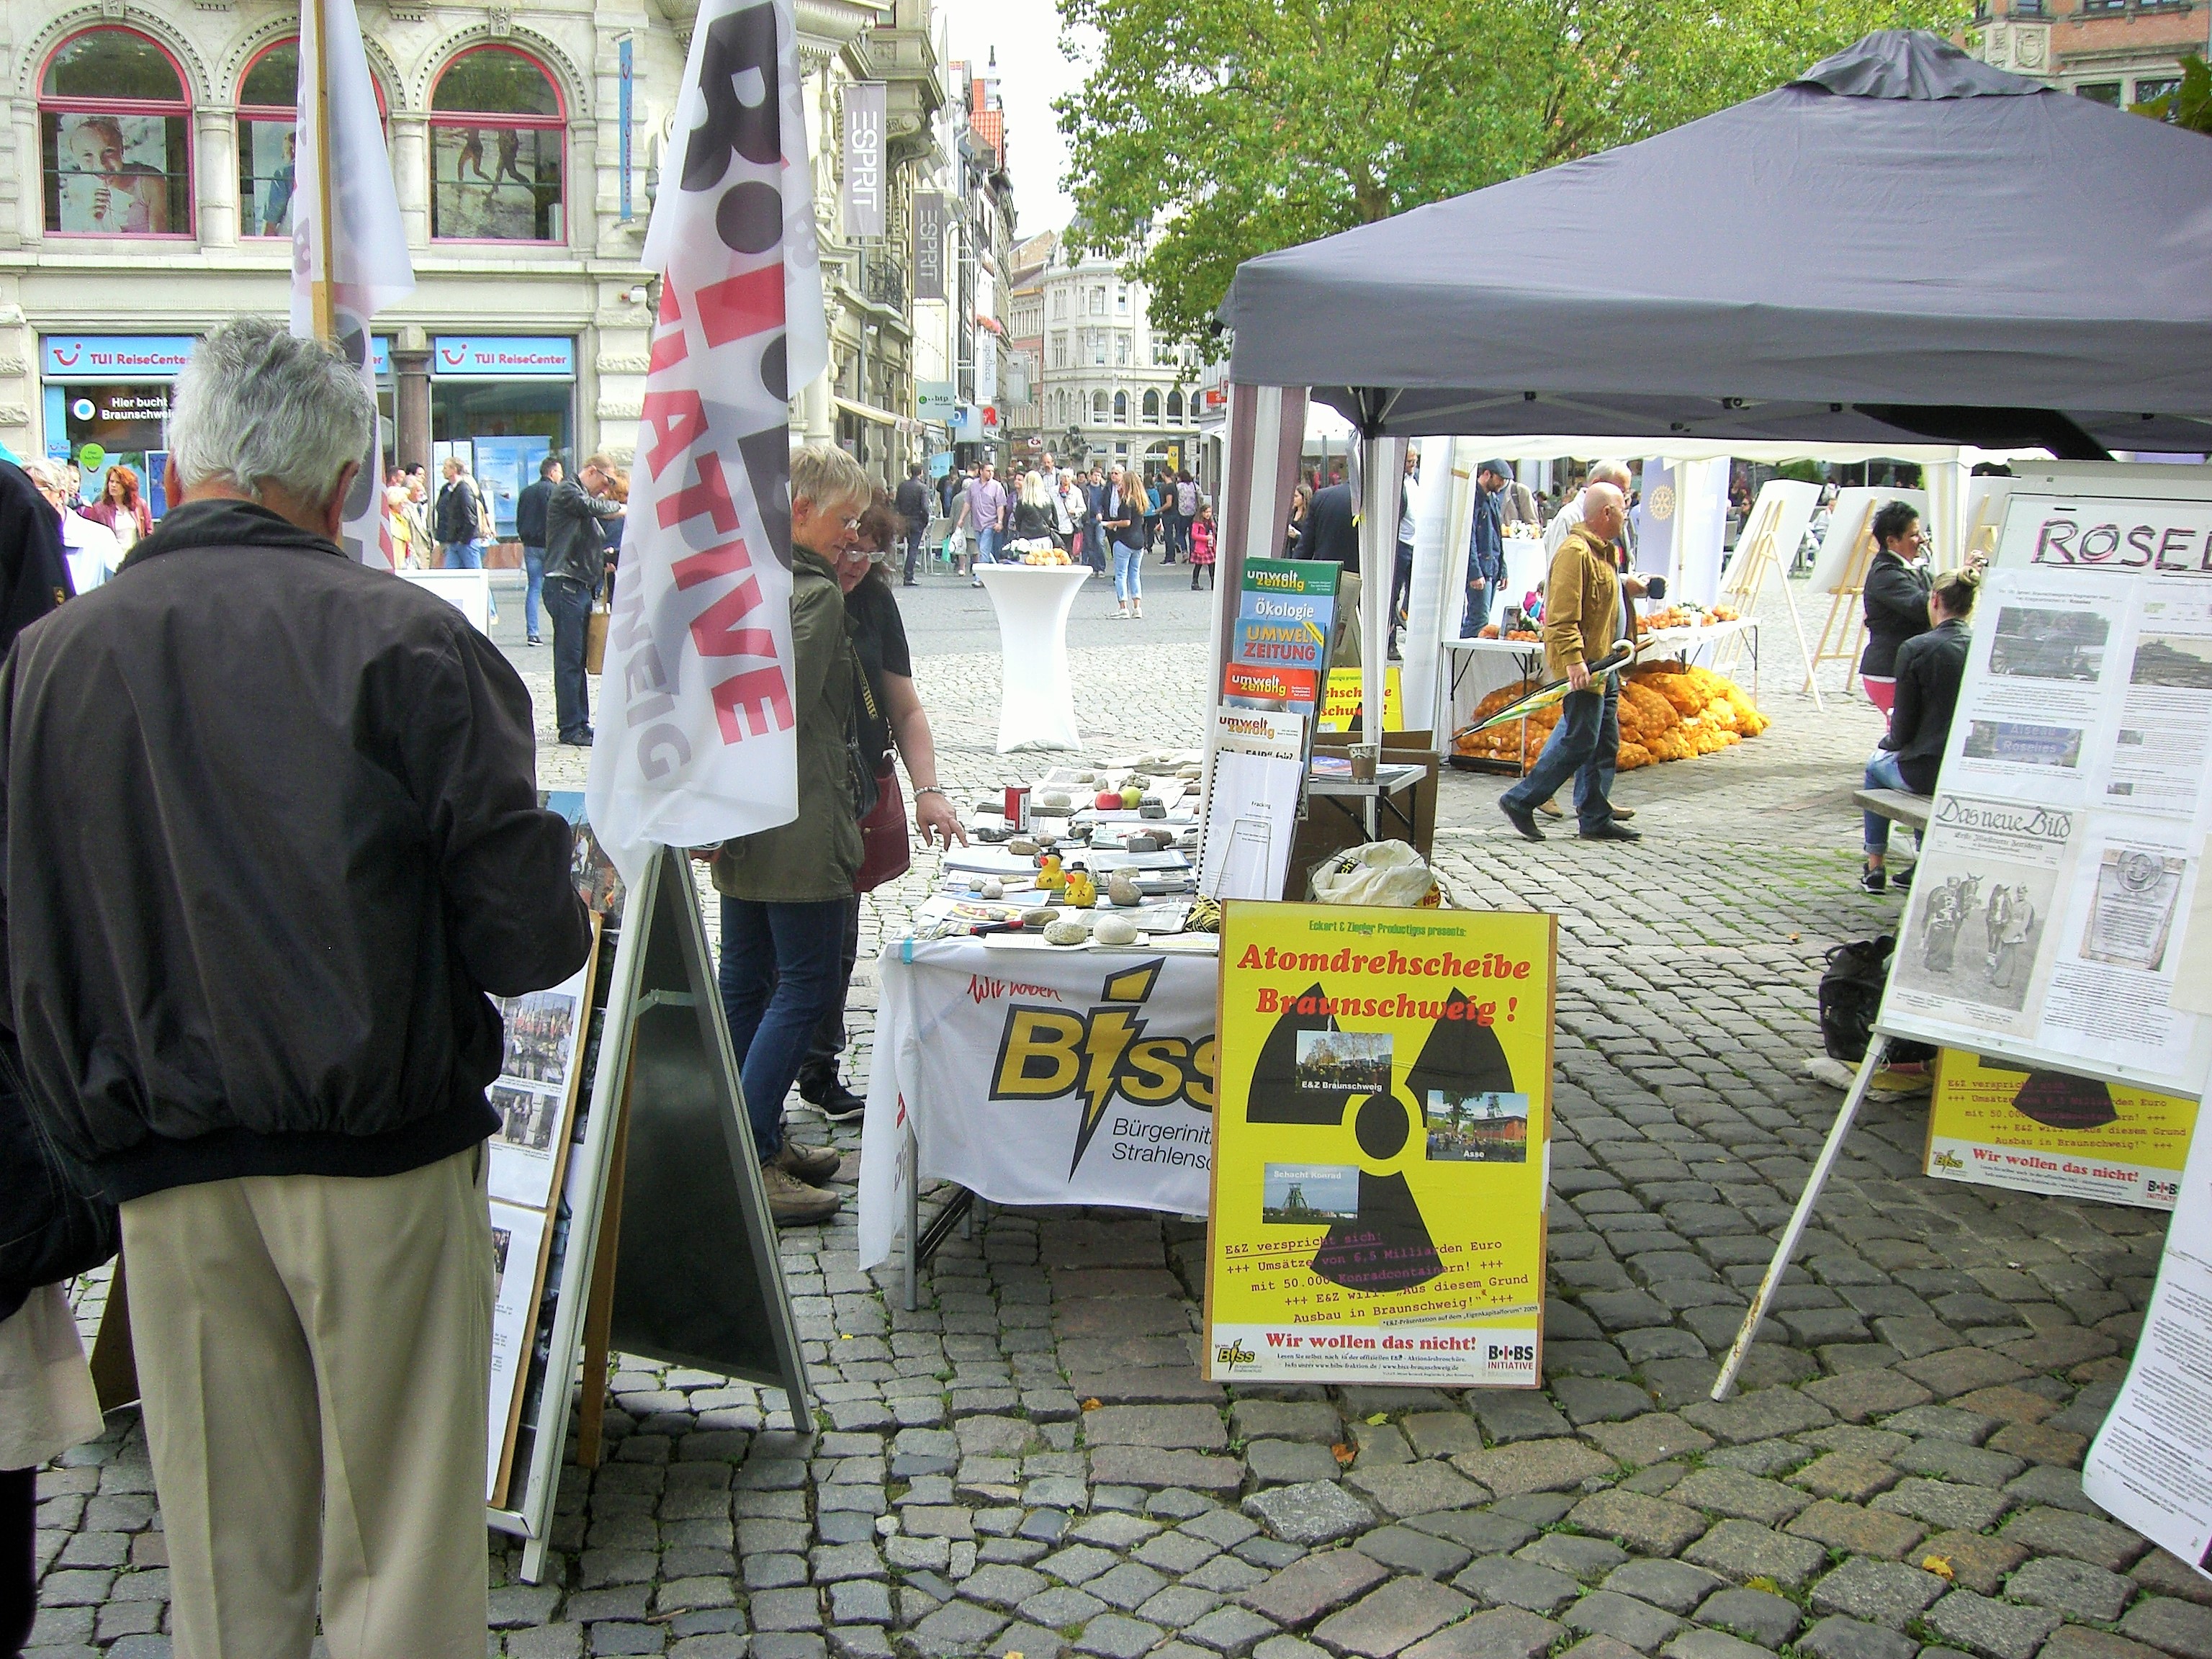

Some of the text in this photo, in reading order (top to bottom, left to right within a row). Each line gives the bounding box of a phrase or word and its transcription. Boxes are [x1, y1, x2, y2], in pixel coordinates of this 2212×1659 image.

[852, 111, 878, 212] ESPRIT
[920, 210, 938, 282] ESPRIT
[91, 354, 112, 364] TUI
[475, 354, 567, 364] TUI ReiseCenter
[112, 397, 168, 408] Hier bucht
[1247, 570, 1298, 582] umwelt
[1256, 577, 1305, 591] zeitung
[1256, 597, 1314, 621] Ökologie
[1244, 642, 1316, 661] ZEITUNG
[1231, 675, 1280, 687] umwelt
[1241, 683, 1287, 697] zeitung
[1219, 716, 1268, 728] umwelt
[1227, 723, 1275, 740] zeitung
[1936, 797, 2071, 838] Das neue Bild
[1236, 943, 1532, 980] Atomdrehscheibe
[1256, 987, 1518, 1027] Braunschweig !
[1322, 1082, 1382, 1092] Braunschweig
[2140, 1098, 2167, 1107] Euro
[1113, 1118, 1211, 1146] Bürgerinit
[2108, 1126, 2148, 1135] diesem
[2153, 1128, 2186, 1136] Grund
[1995, 1137, 2033, 1146] Ausbau
[1972, 1148, 2002, 1163] Wir
[2005, 1156, 2058, 1172] wollen
[2062, 1161, 2088, 1175] das
[2092, 1166, 2139, 1183] nicht!
[1225, 1244, 1249, 1254] E&Z
[1256, 1236, 1336, 1251] verspricht
[1227, 1264, 1250, 1274] +++
[1258, 1259, 1314, 1272] Umsätze
[1322, 1256, 1345, 1265] von
[1383, 1244, 1462, 1260] Milliarden
[1470, 1241, 1503, 1251] Euro
[1251, 1281, 1275, 1292] mit
[1284, 1276, 1330, 1290] 50.000
[1480, 1260, 1503, 1270] +++
[1285, 1297, 1308, 1306] +++
[1316, 1292, 1340, 1303] E&Z
[1434, 1280, 1482, 1292] diesem
[1488, 1274, 1529, 1287] Grund
[1293, 1310, 1341, 1323] Ausbau
[1350, 1308, 1365, 1318] in
[1491, 1295, 1514, 1304] +++
[1266, 1333, 1477, 1350] Wir wollen das nicht!
[1488, 1362, 1534, 1370] INITIATIVE
